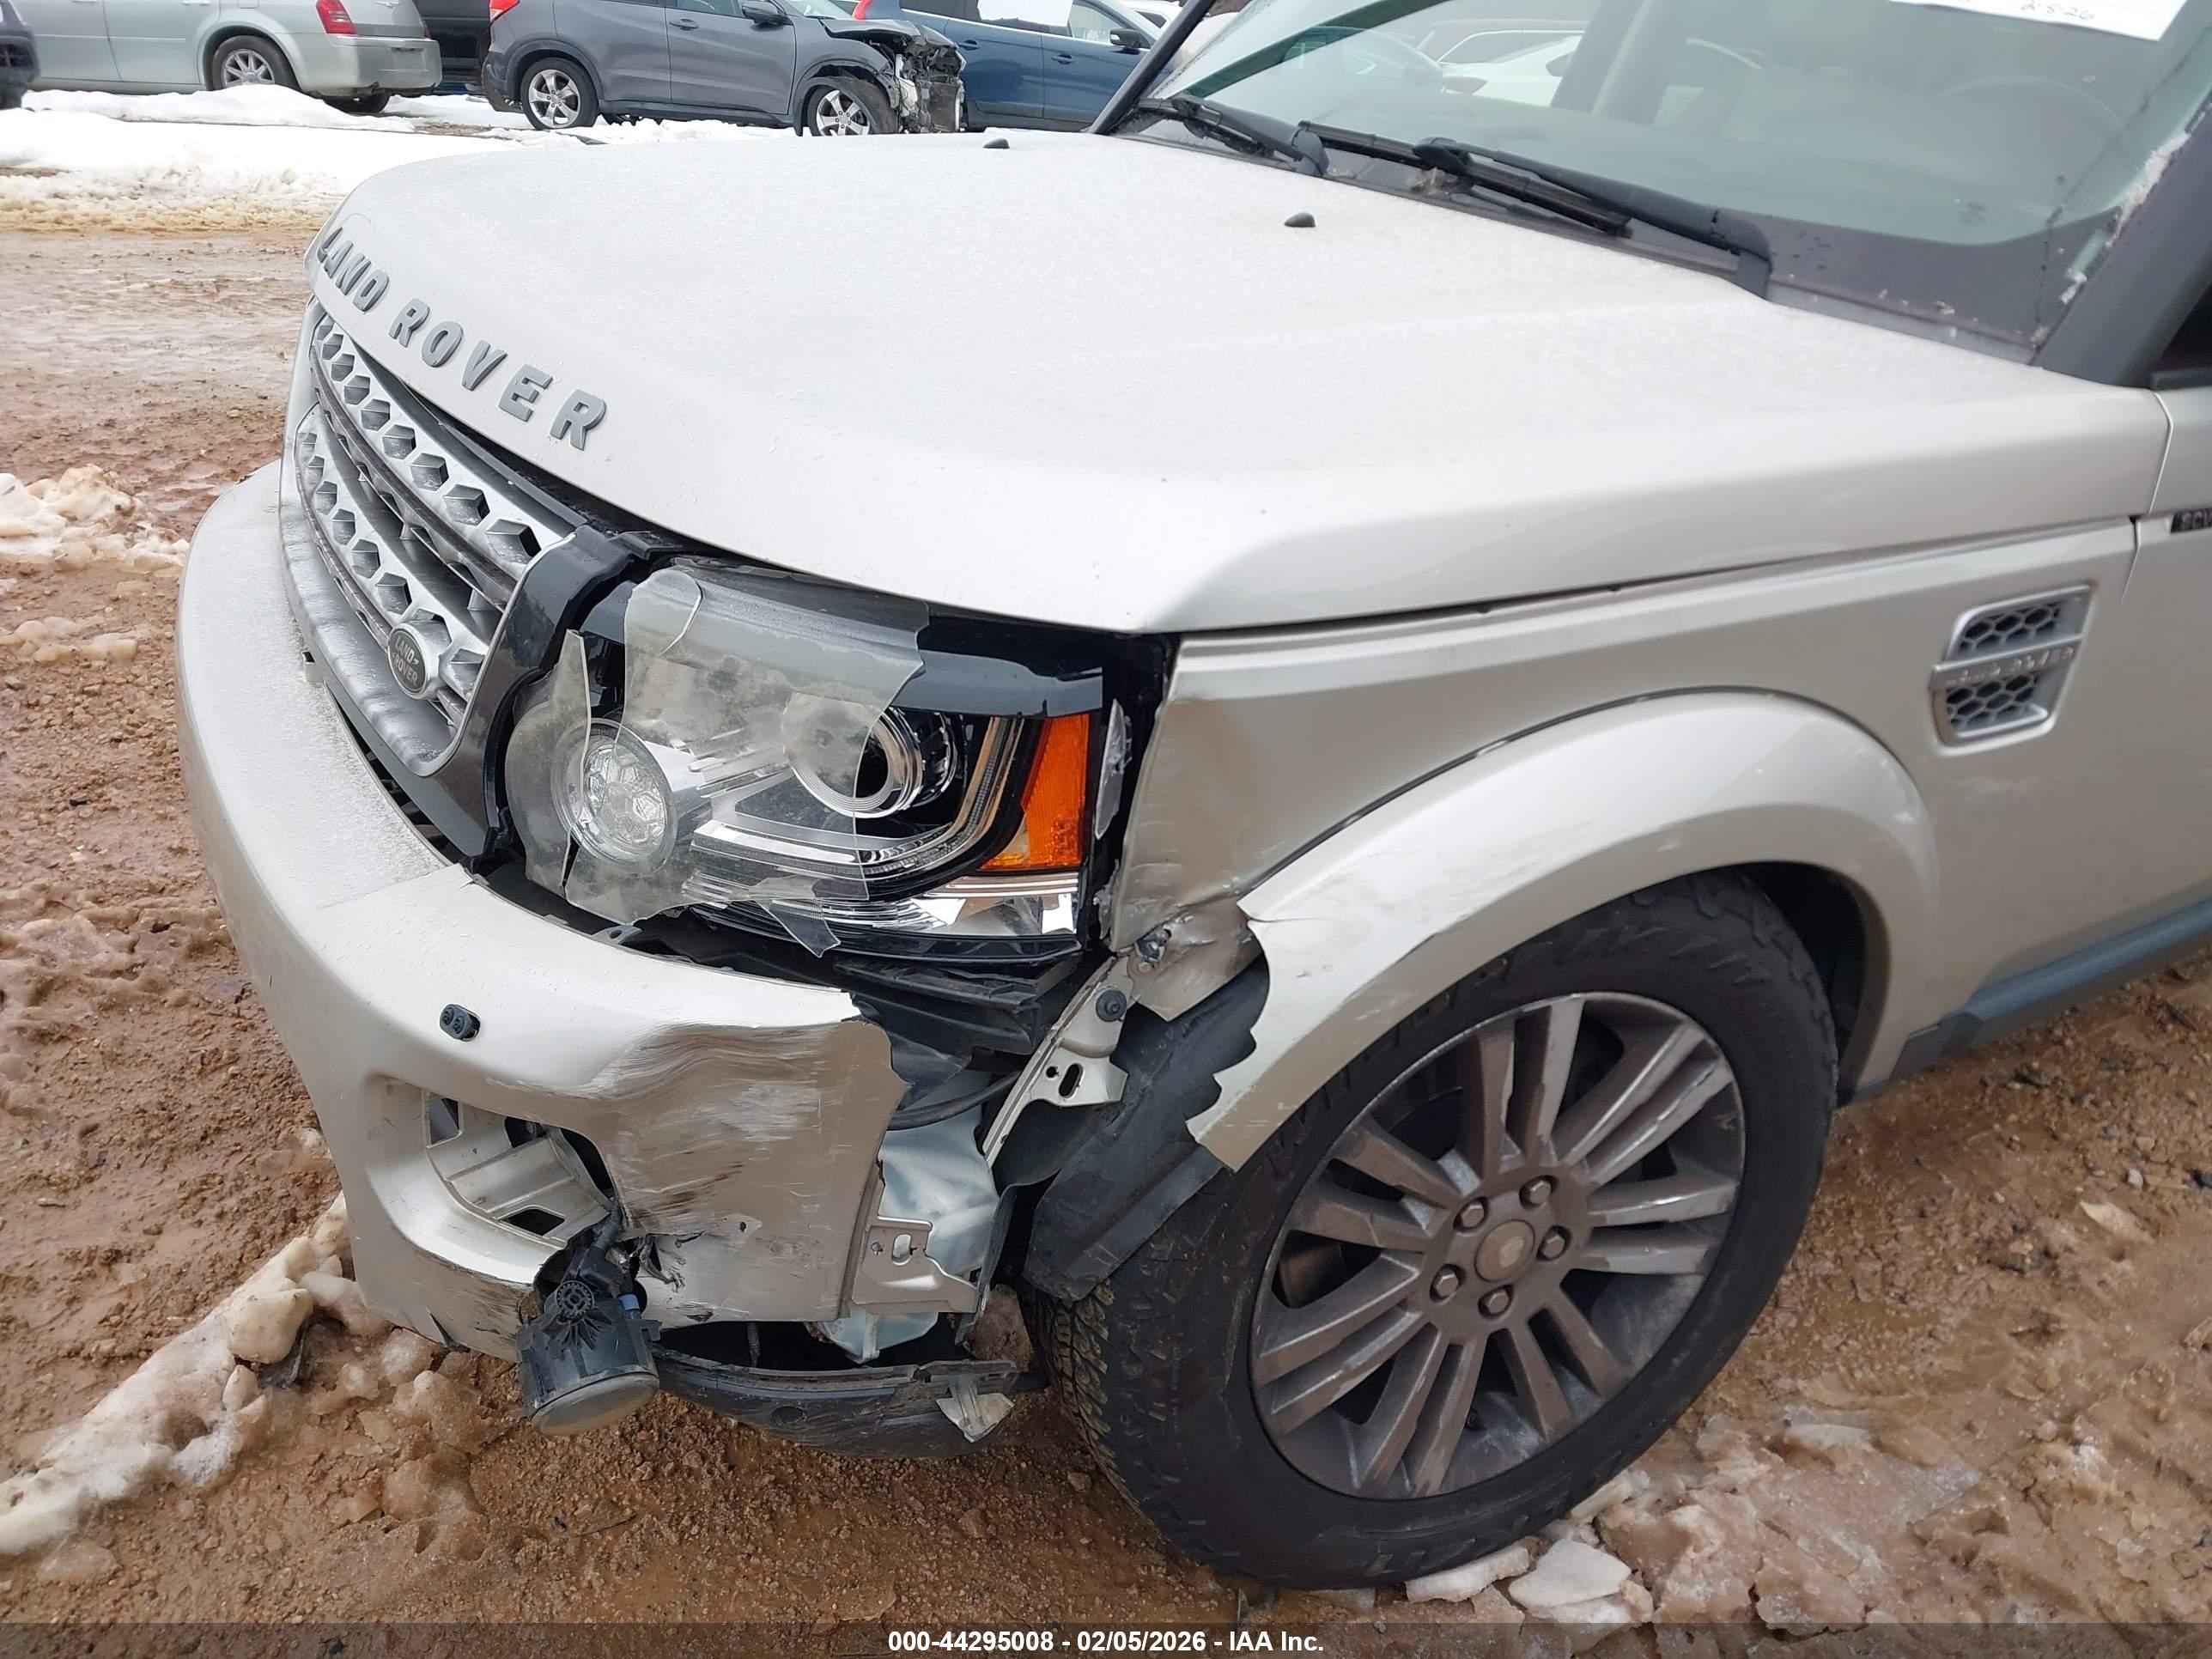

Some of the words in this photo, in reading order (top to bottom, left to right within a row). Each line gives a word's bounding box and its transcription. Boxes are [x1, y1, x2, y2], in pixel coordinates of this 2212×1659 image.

[317, 227, 390, 313] LAND
[388, 298, 607, 452] ROVER
[394, 635, 416, 665] LAND
[392, 655, 419, 686] ROVER
